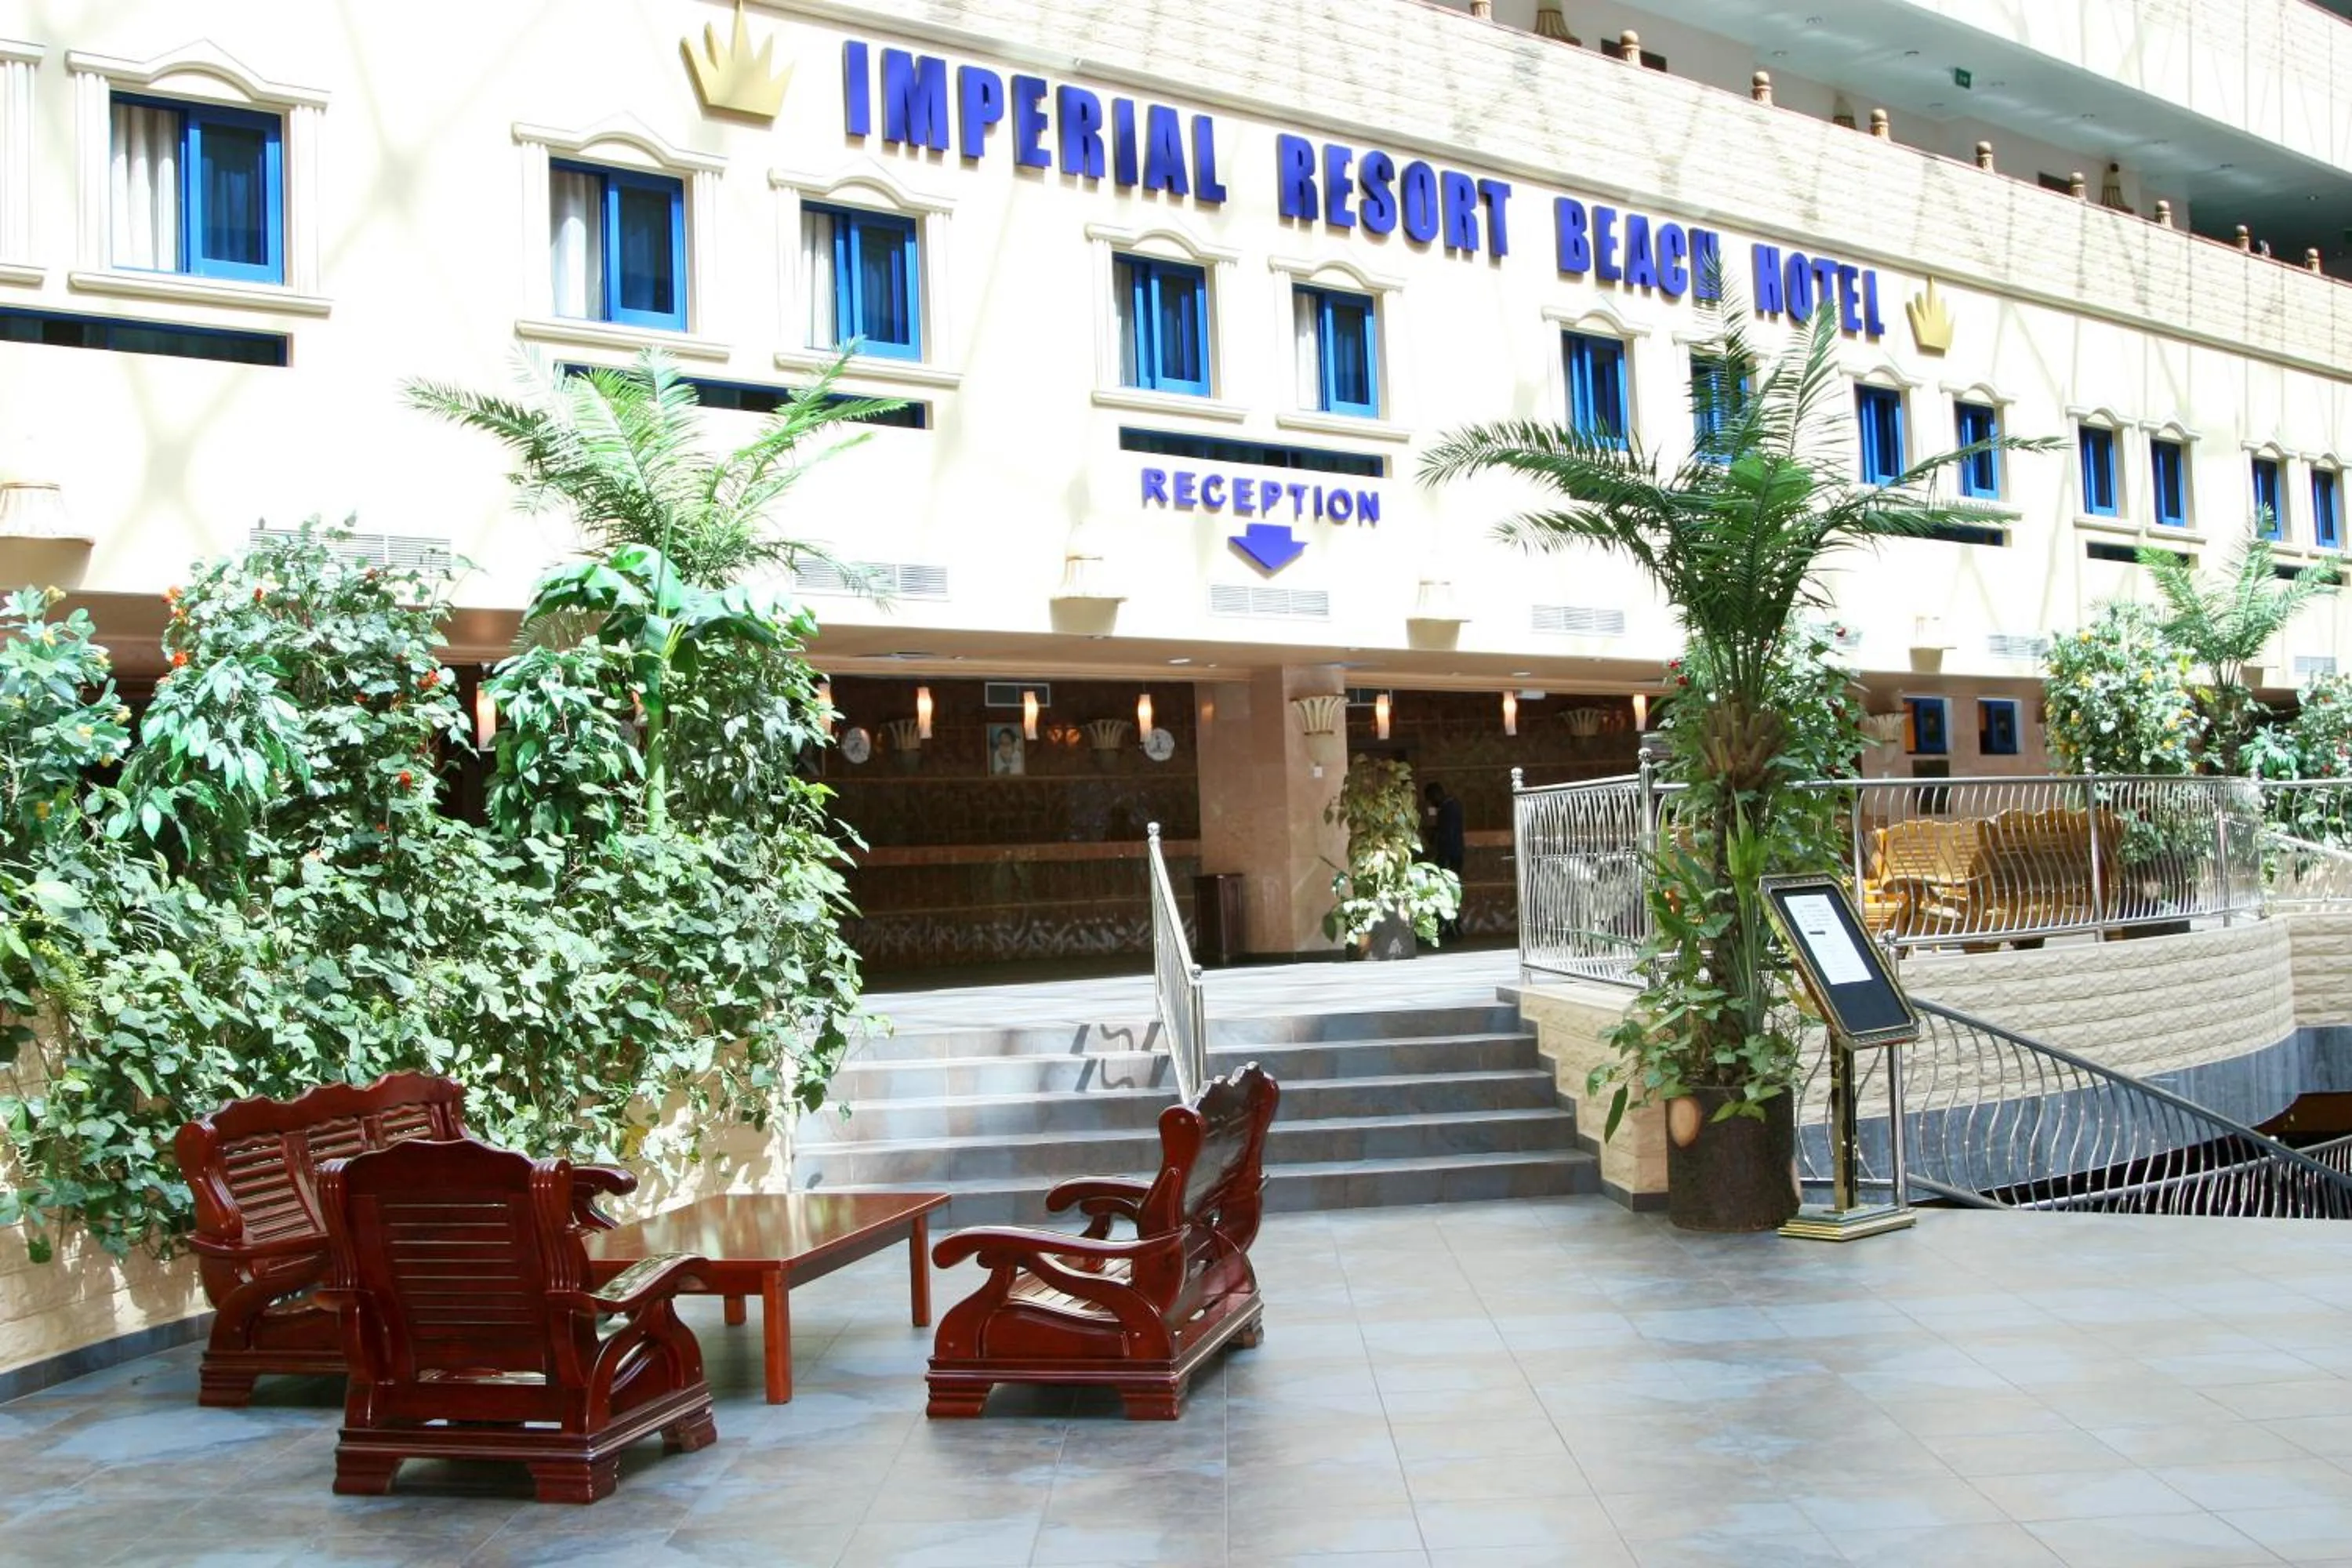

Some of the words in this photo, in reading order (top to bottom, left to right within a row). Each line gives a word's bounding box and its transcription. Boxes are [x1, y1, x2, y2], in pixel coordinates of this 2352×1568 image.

[843, 39, 1227, 203] IMPERIAL
[1276, 132, 1512, 257] RESORT
[1554, 196, 1722, 301] BEACH
[1751, 242, 1886, 336] HOTEL
[1141, 466, 1381, 524] RECEPTION
